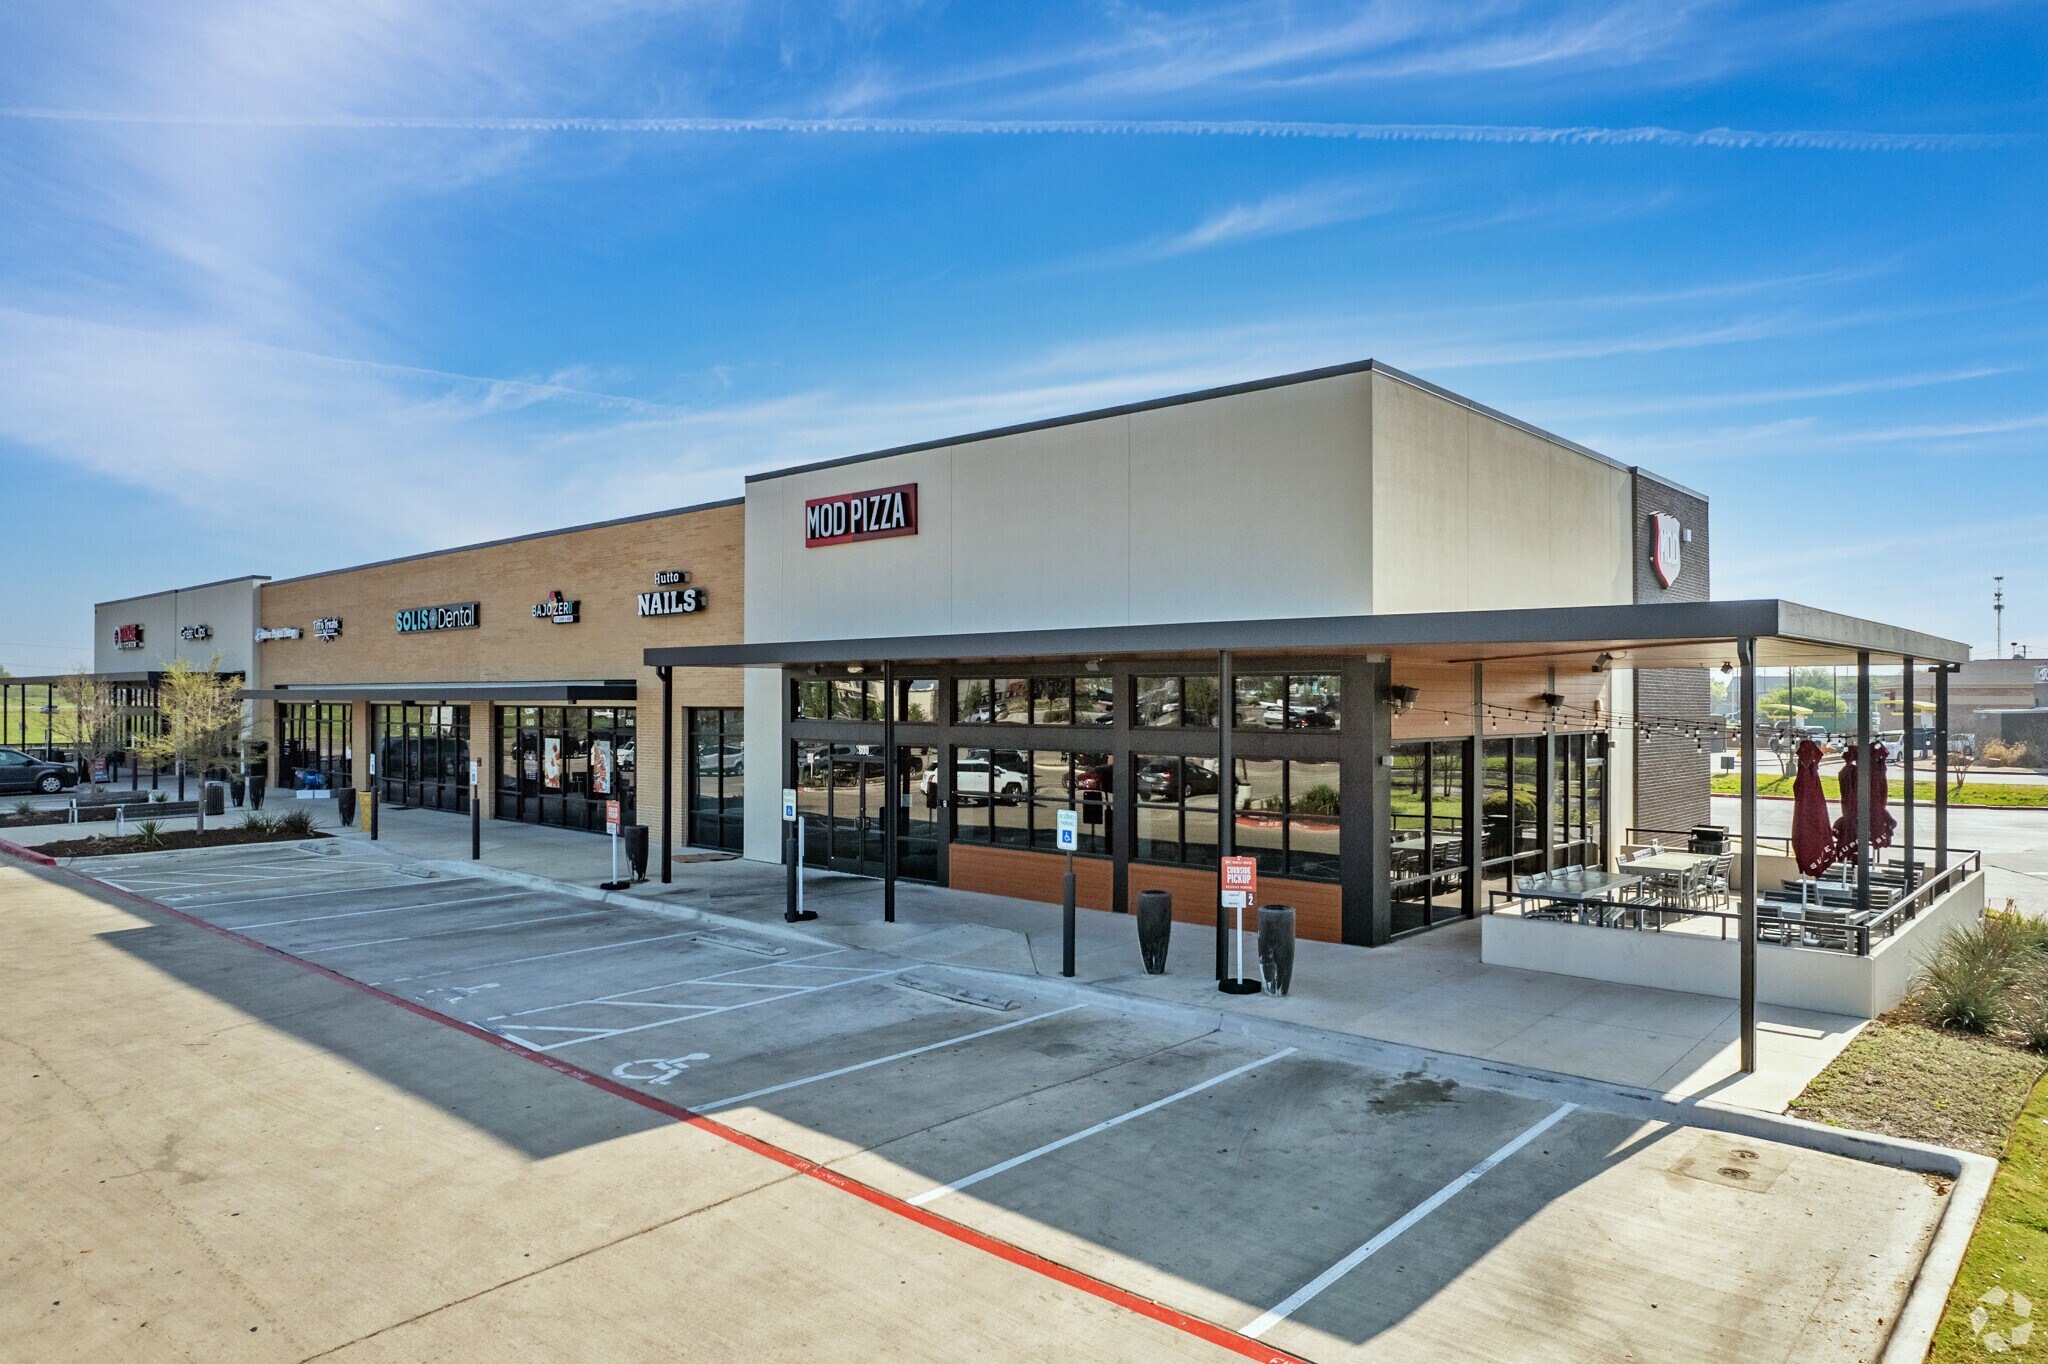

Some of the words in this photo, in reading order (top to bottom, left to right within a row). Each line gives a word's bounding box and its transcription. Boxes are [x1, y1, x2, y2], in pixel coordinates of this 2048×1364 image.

[806, 502, 846, 539] MOD
[850, 492, 905, 534] PIZZA
[654, 573, 680, 585] Hutto
[531, 603, 552, 617] BAJO
[553, 601, 573, 615] ZERO
[637, 589, 696, 616] NAILS
[396, 610, 429, 632] SOLIS
[437, 603, 475, 629] Dental
[180, 626, 194, 640] Great
[194, 624, 206, 641] Clips
[1226, 866, 1252, 875] CURBSIDE
[1226, 873, 1252, 884] PICKUP
[1248, 895, 1254, 906] 2
